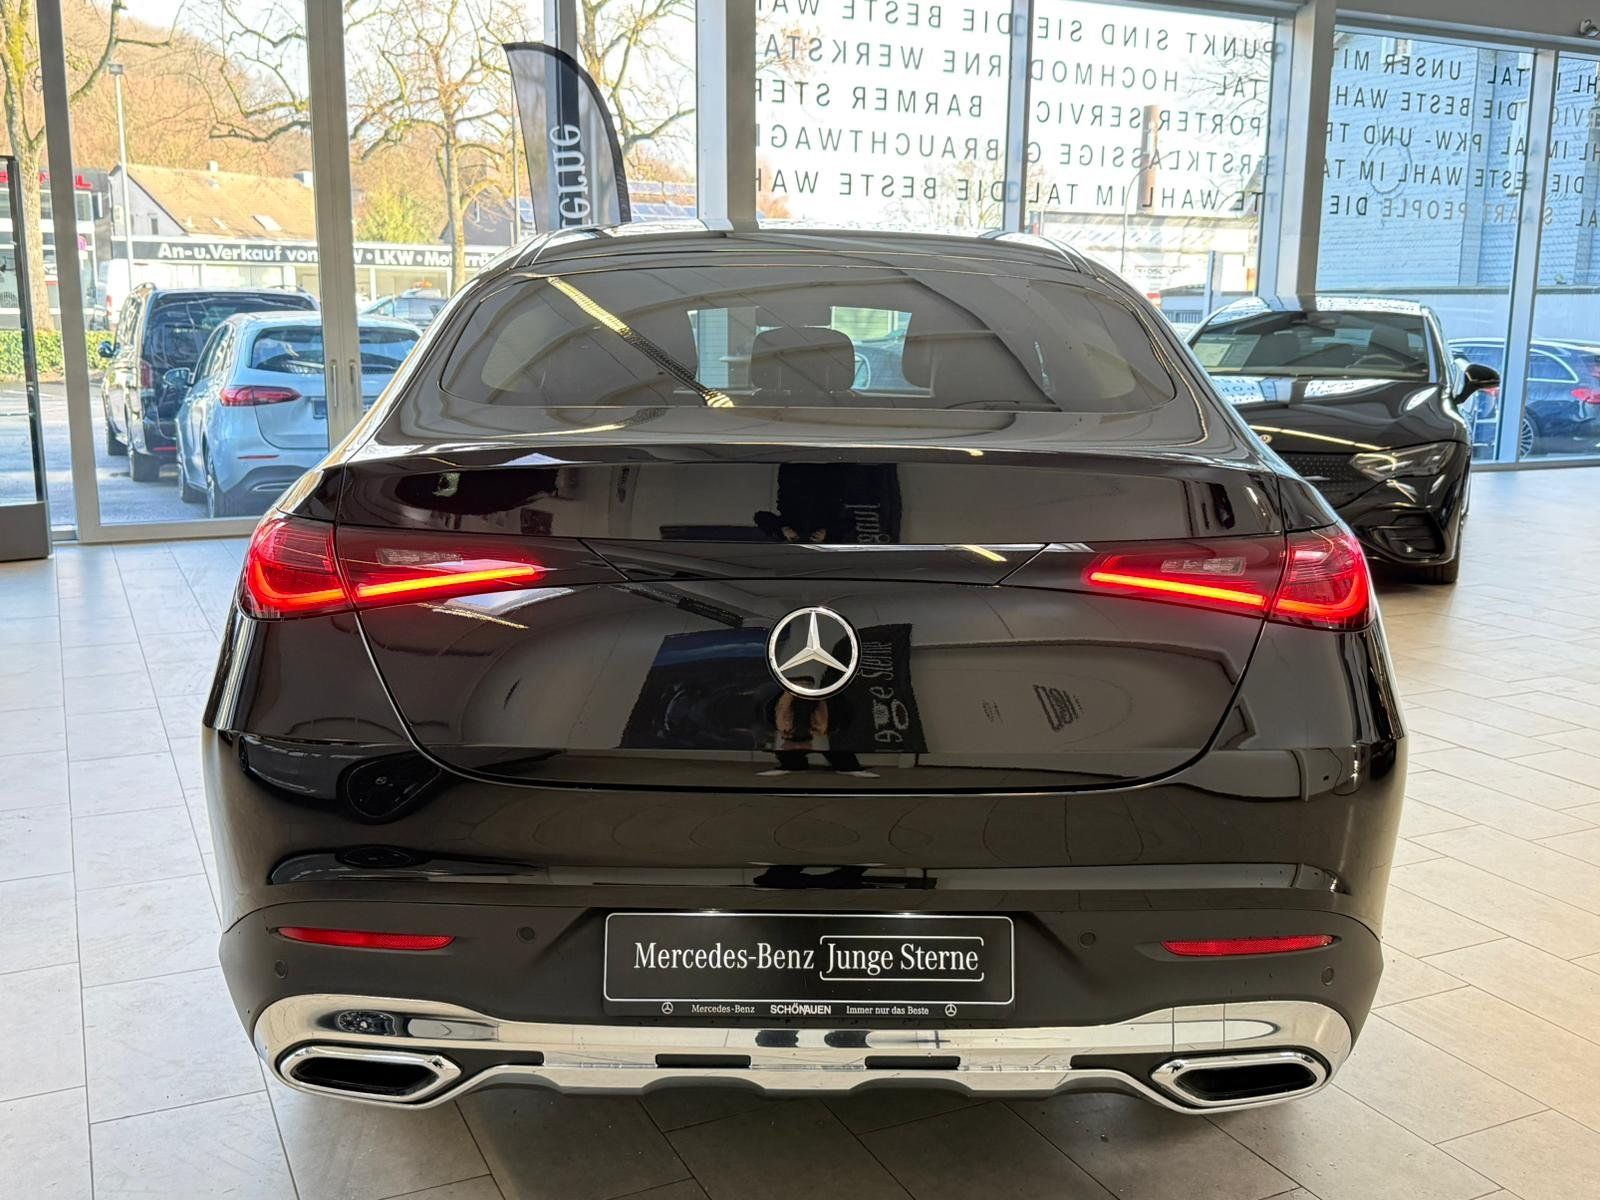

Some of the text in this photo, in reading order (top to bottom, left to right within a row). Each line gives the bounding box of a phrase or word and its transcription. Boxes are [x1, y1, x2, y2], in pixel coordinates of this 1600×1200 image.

[375, 249, 415, 265] LKW
[633, 941, 980, 976] Mercedes-Benz Junge Sterne
[691, 1003, 756, 1014] Mercedes-Benz
[846, 1004, 873, 1015] Immer
[875, 1006, 889, 1015] nur
[892, 1005, 907, 1016] das
[909, 1006, 930, 1016] Beste
